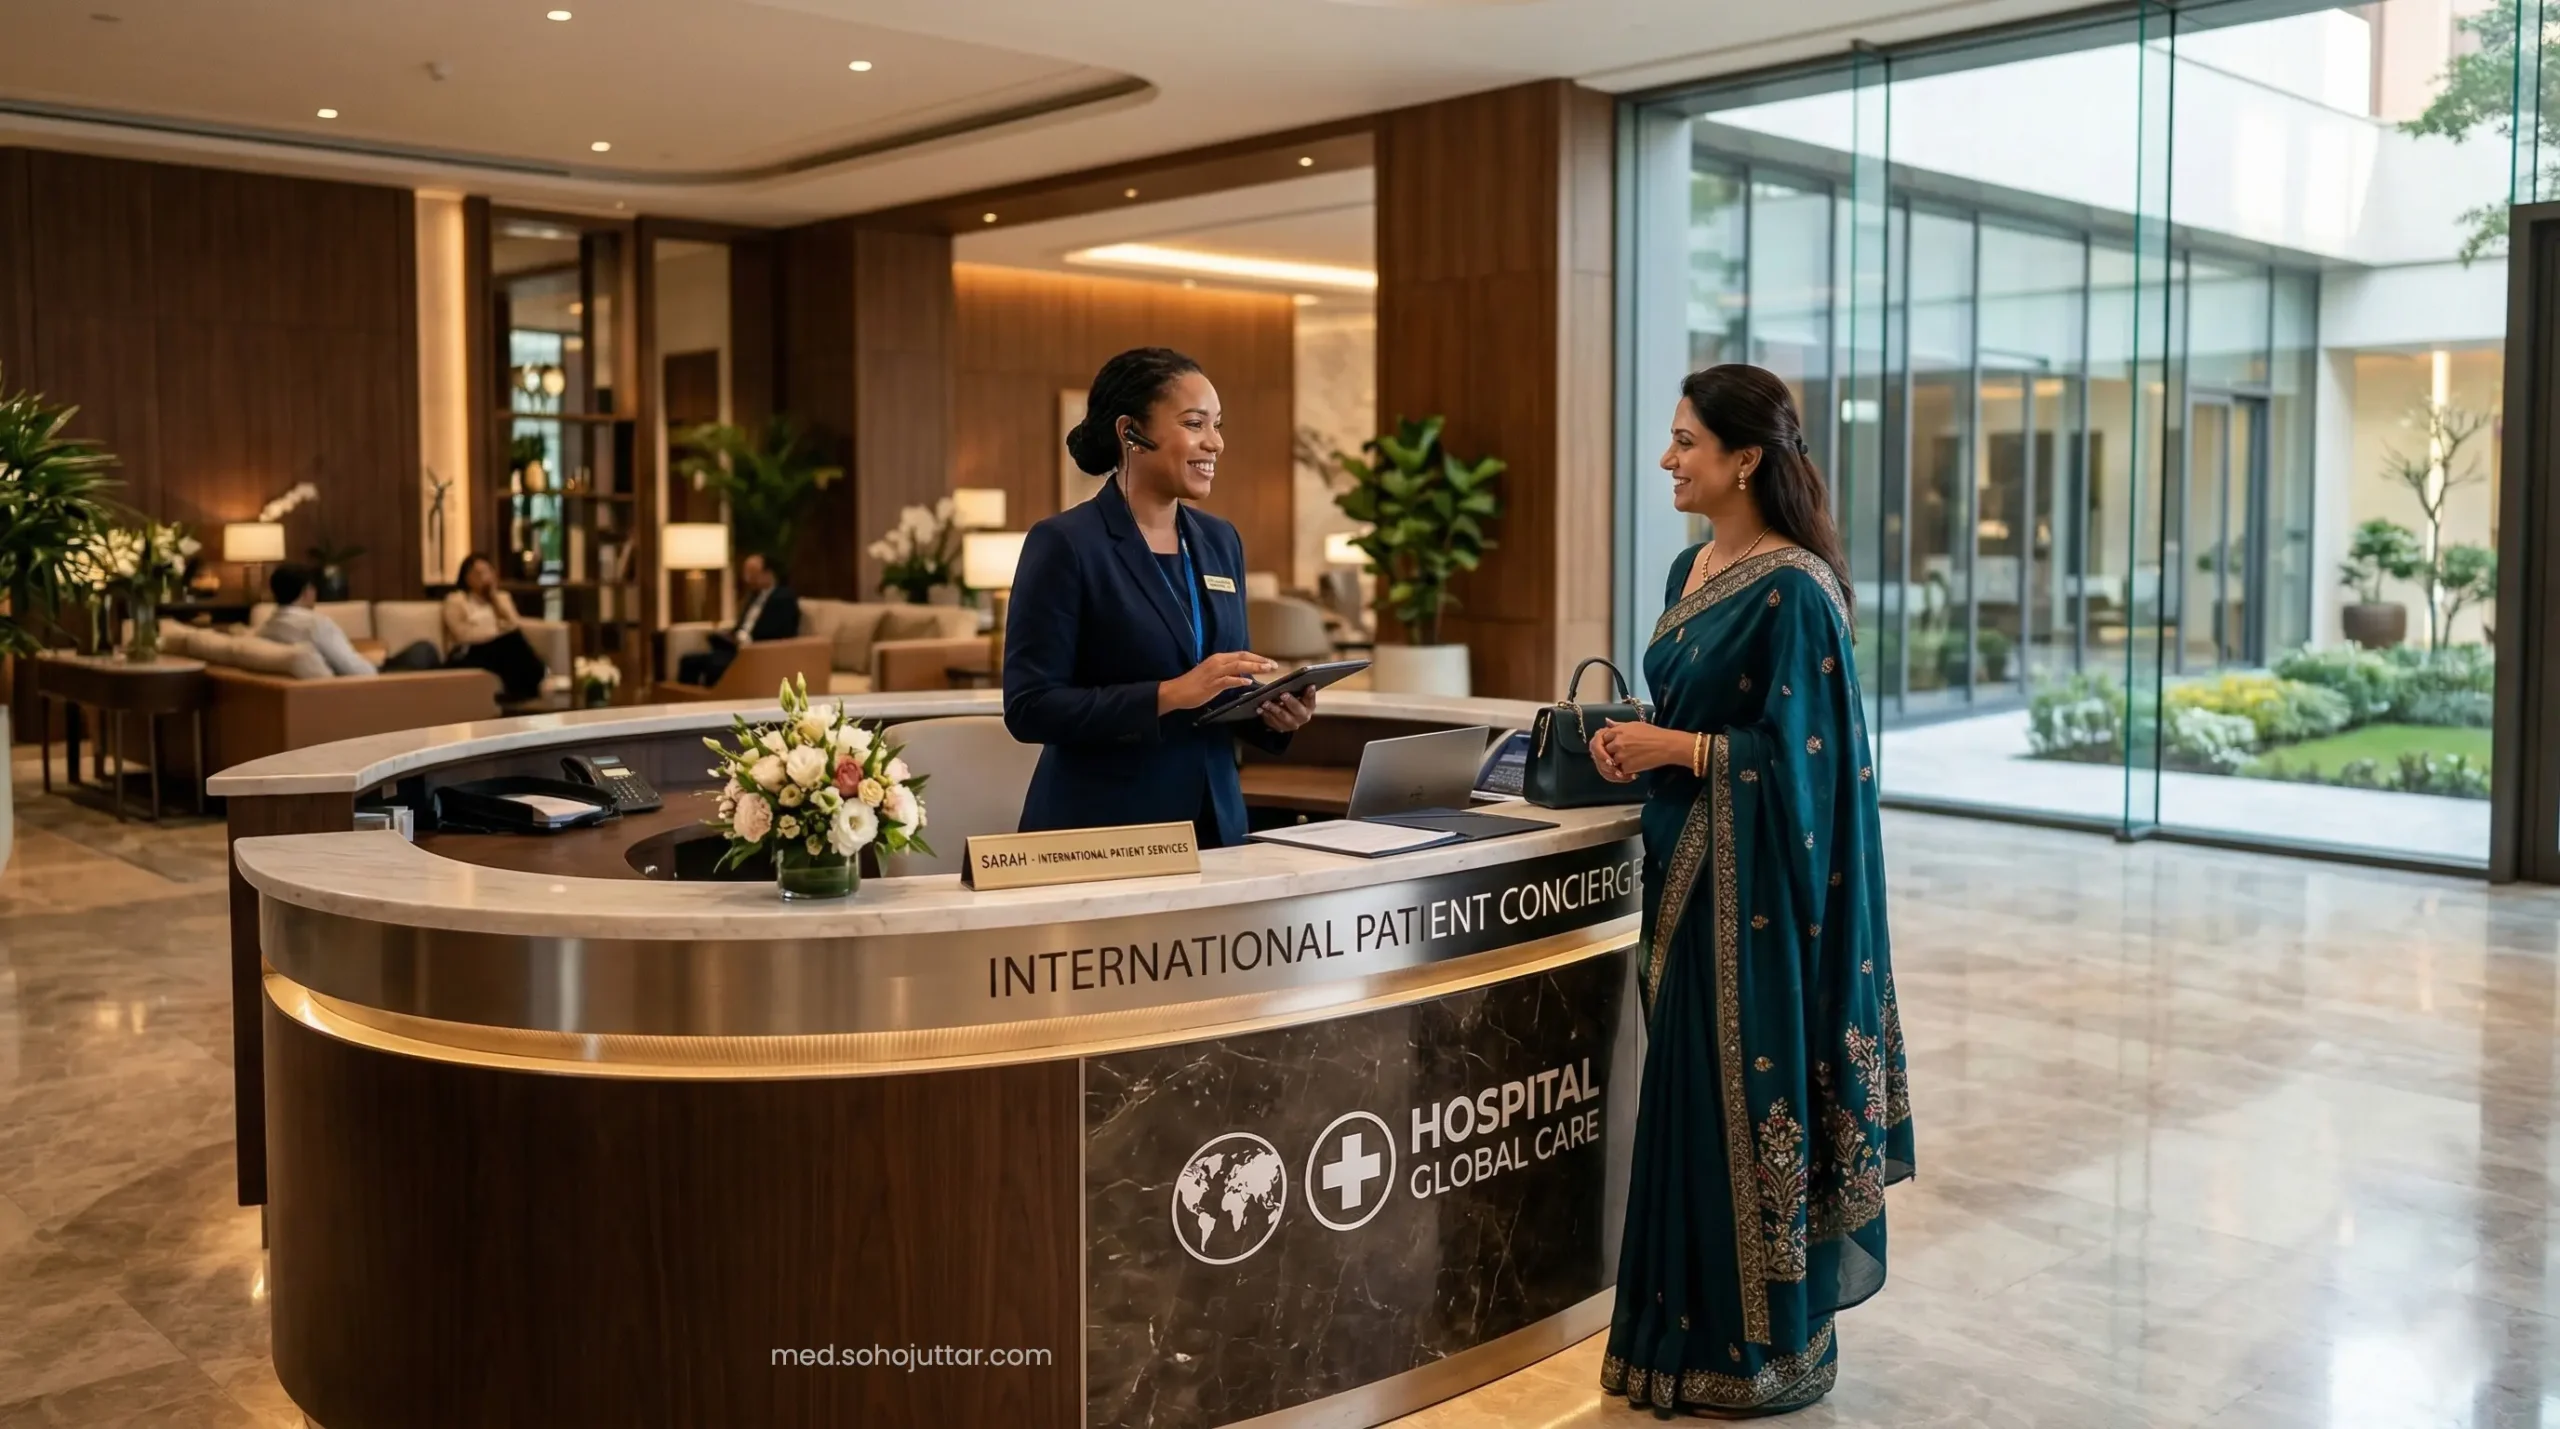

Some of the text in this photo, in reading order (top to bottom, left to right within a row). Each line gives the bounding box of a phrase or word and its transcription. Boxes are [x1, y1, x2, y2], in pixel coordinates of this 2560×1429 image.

[981, 852, 1028, 869] SARAH
[1038, 848, 1108, 865] INTERNATIONAL
[1110, 845, 1145, 858] PATIENT
[1147, 842, 1189, 856] SERVICES
[989, 858, 1643, 998] INTERNATIONAL PATIENT CONCIERGE
[1411, 1057, 1599, 1154] HOSPITAL
[1410, 1108, 1600, 1200] GLOBAL CARE
